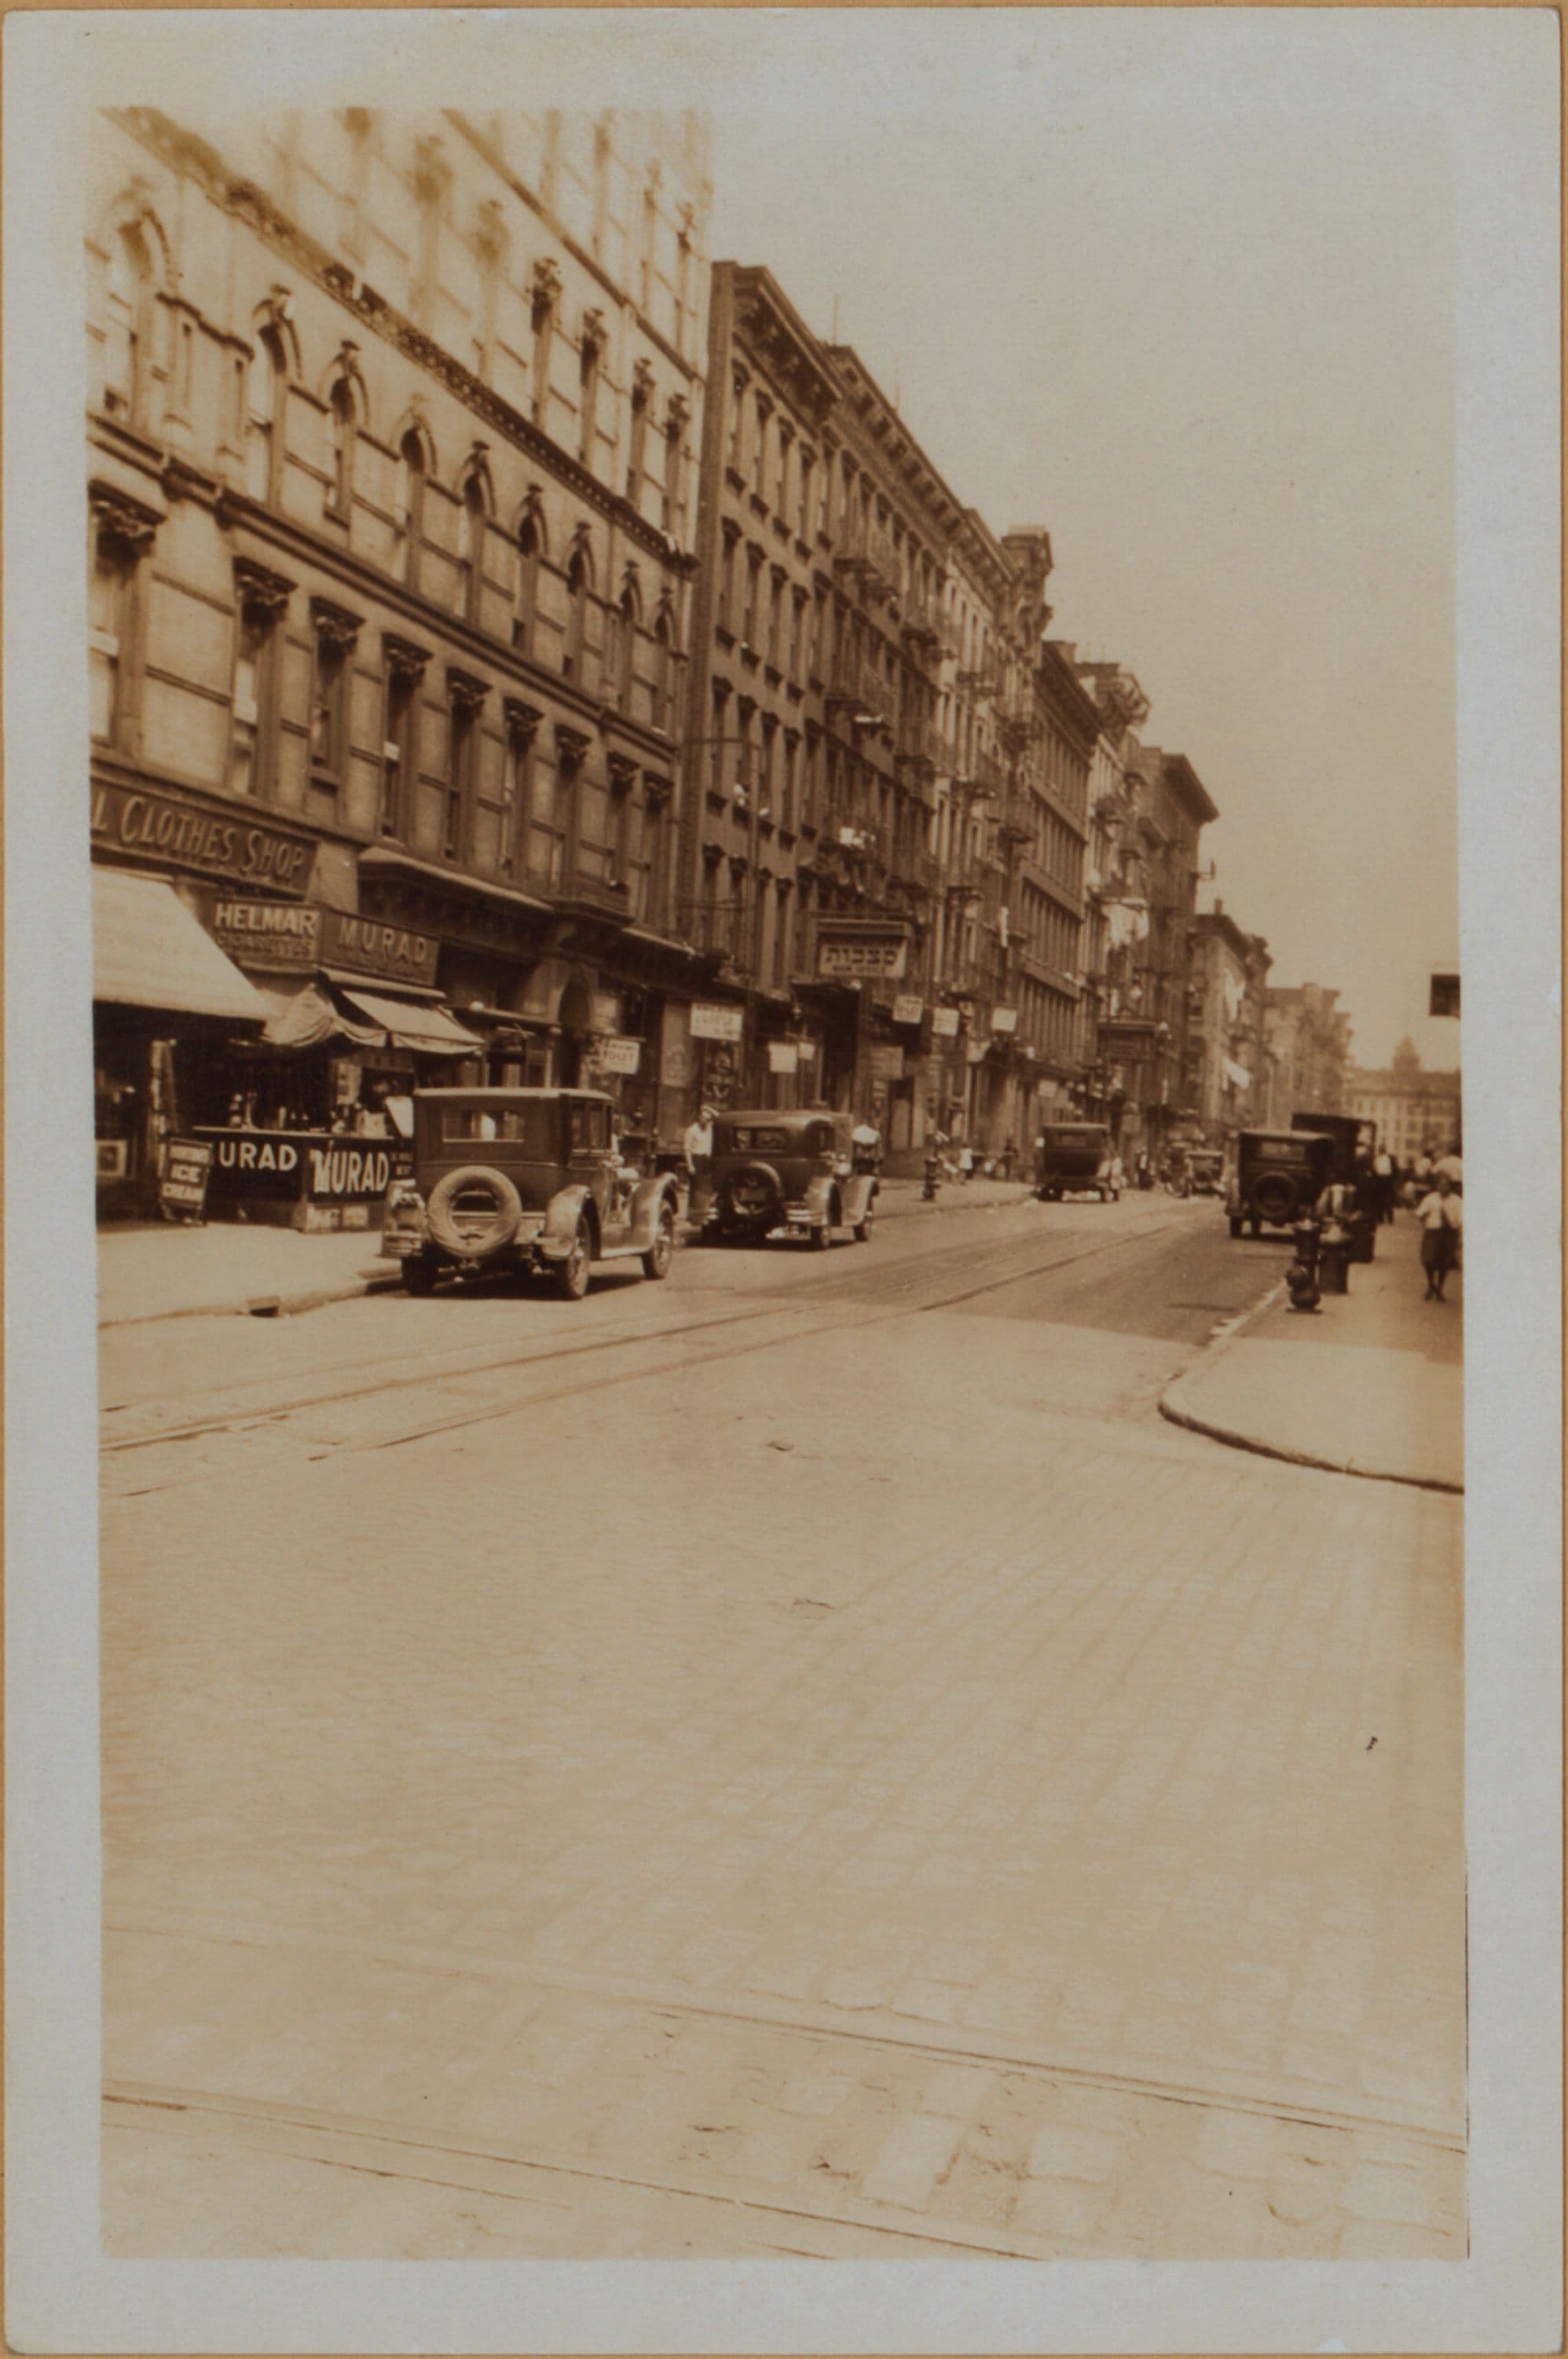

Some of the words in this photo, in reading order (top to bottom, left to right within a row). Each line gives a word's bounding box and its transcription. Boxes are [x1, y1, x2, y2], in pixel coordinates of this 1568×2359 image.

[121, 795, 237, 862] CLOTHES
[242, 830, 304, 879] SHOP
[214, 902, 320, 937] HELMAR
[338, 916, 427, 963] MURAD
[170, 1164, 202, 1183] ICE
[219, 1142, 298, 1172] URAD
[309, 1149, 389, 1194] MURAD
